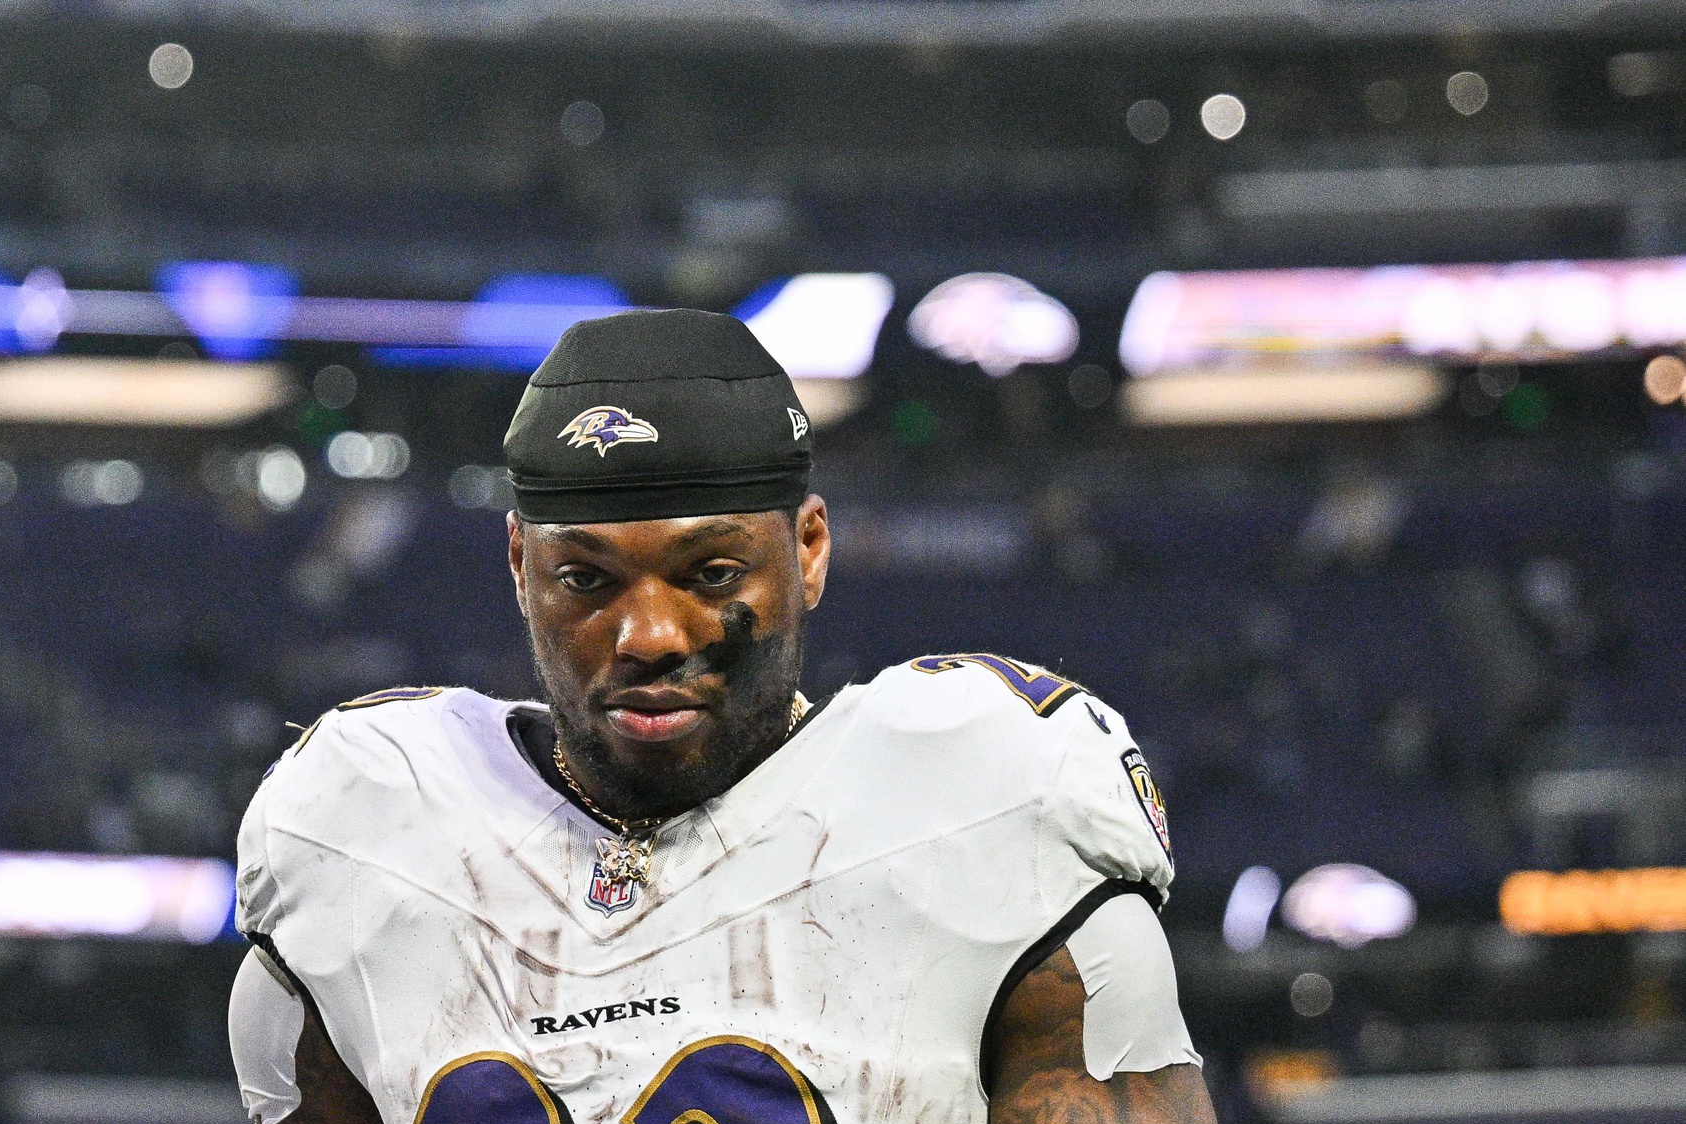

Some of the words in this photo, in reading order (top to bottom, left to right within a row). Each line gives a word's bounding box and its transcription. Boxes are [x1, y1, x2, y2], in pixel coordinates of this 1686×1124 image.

[582, 411, 610, 435] B
[592, 879, 628, 904] NFL
[530, 996, 682, 1035] RAVENS
